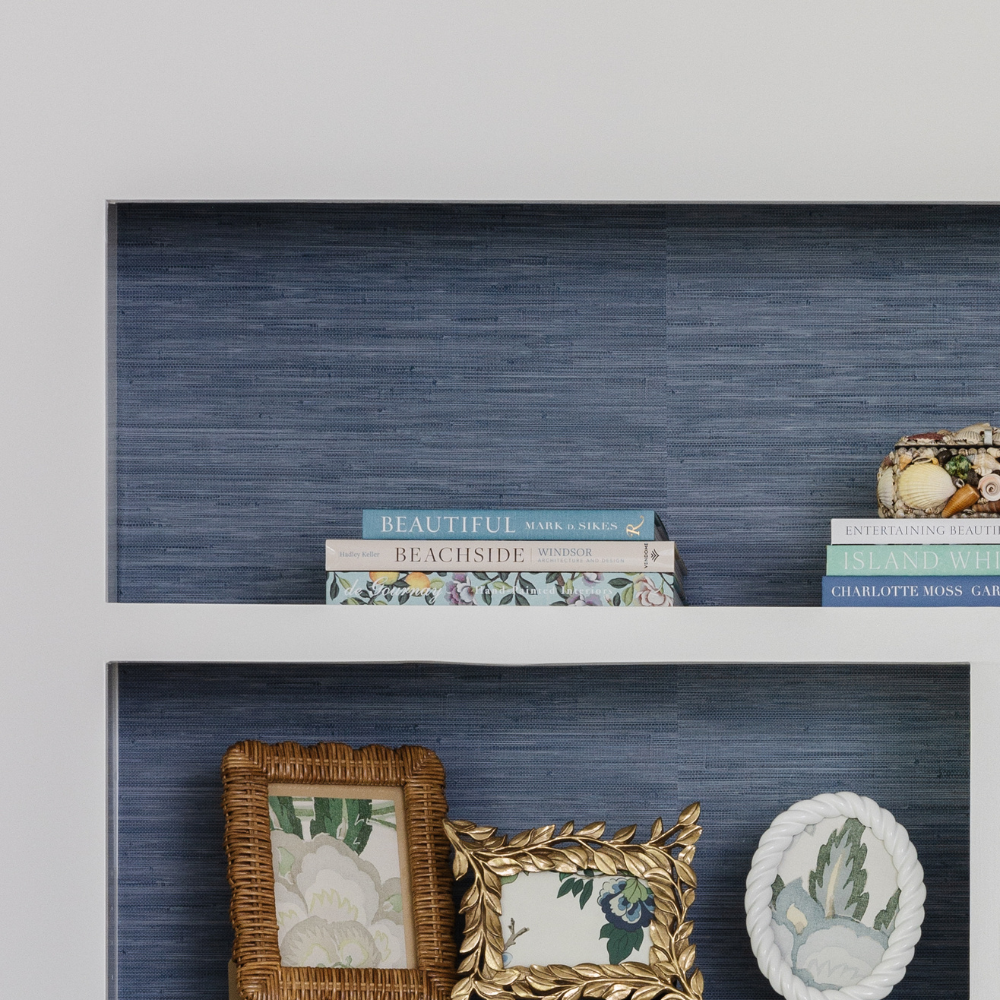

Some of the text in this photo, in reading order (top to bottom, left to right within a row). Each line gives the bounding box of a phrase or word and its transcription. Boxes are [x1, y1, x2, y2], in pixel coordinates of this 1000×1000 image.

[381, 516, 516, 533] BEAUTIFUL
[525, 521, 563, 530] MARK
[579, 521, 618, 530] SIKES
[845, 525, 946, 536] ENTERTAINING
[339, 551, 361, 559] Hadley
[395, 547, 525, 563] BEACHSIDE
[538, 548, 592, 557] WINDSOR
[843, 550, 939, 571] ISLAND
[344, 577, 442, 604] de Gournay
[562, 586, 613, 595] Interiors
[831, 585, 963, 597] CHARLOTTE MOSS
